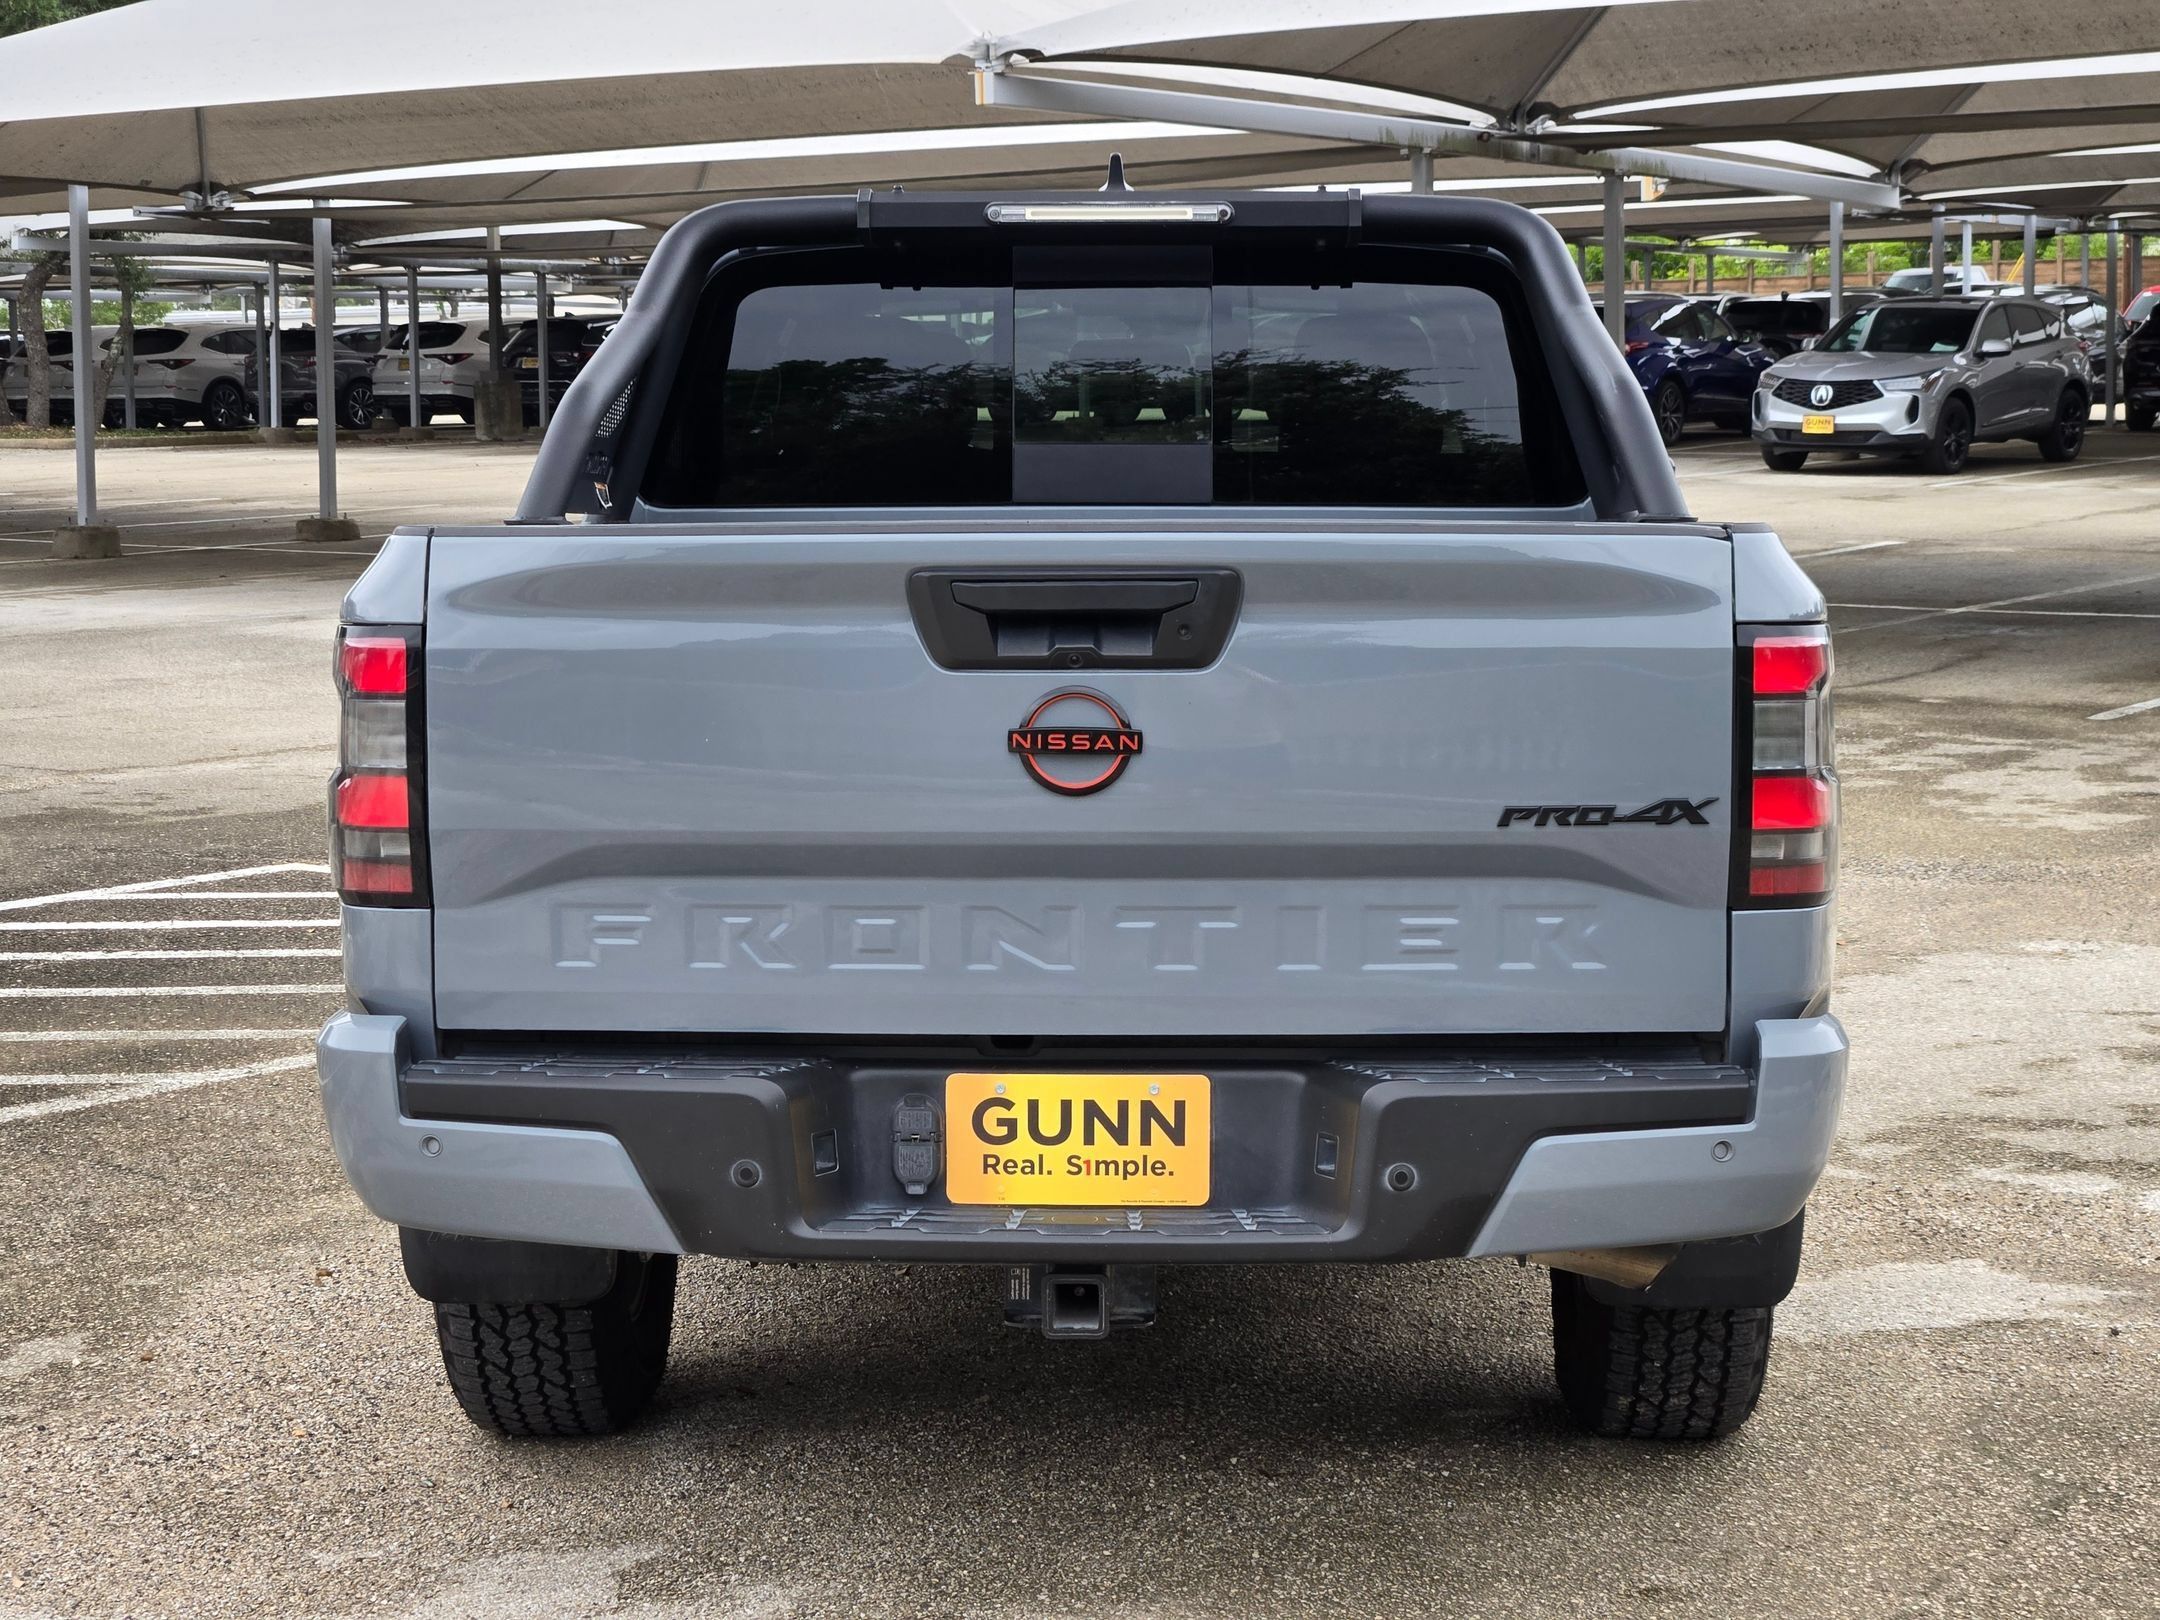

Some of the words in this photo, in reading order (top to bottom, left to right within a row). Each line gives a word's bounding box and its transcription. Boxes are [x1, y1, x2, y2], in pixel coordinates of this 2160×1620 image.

[1012, 733, 1139, 750] NISSAN
[552, 902, 1607, 970] FRONTIER
[971, 1096, 1186, 1147] GUNN
[982, 1154, 1052, 1176] Real.
